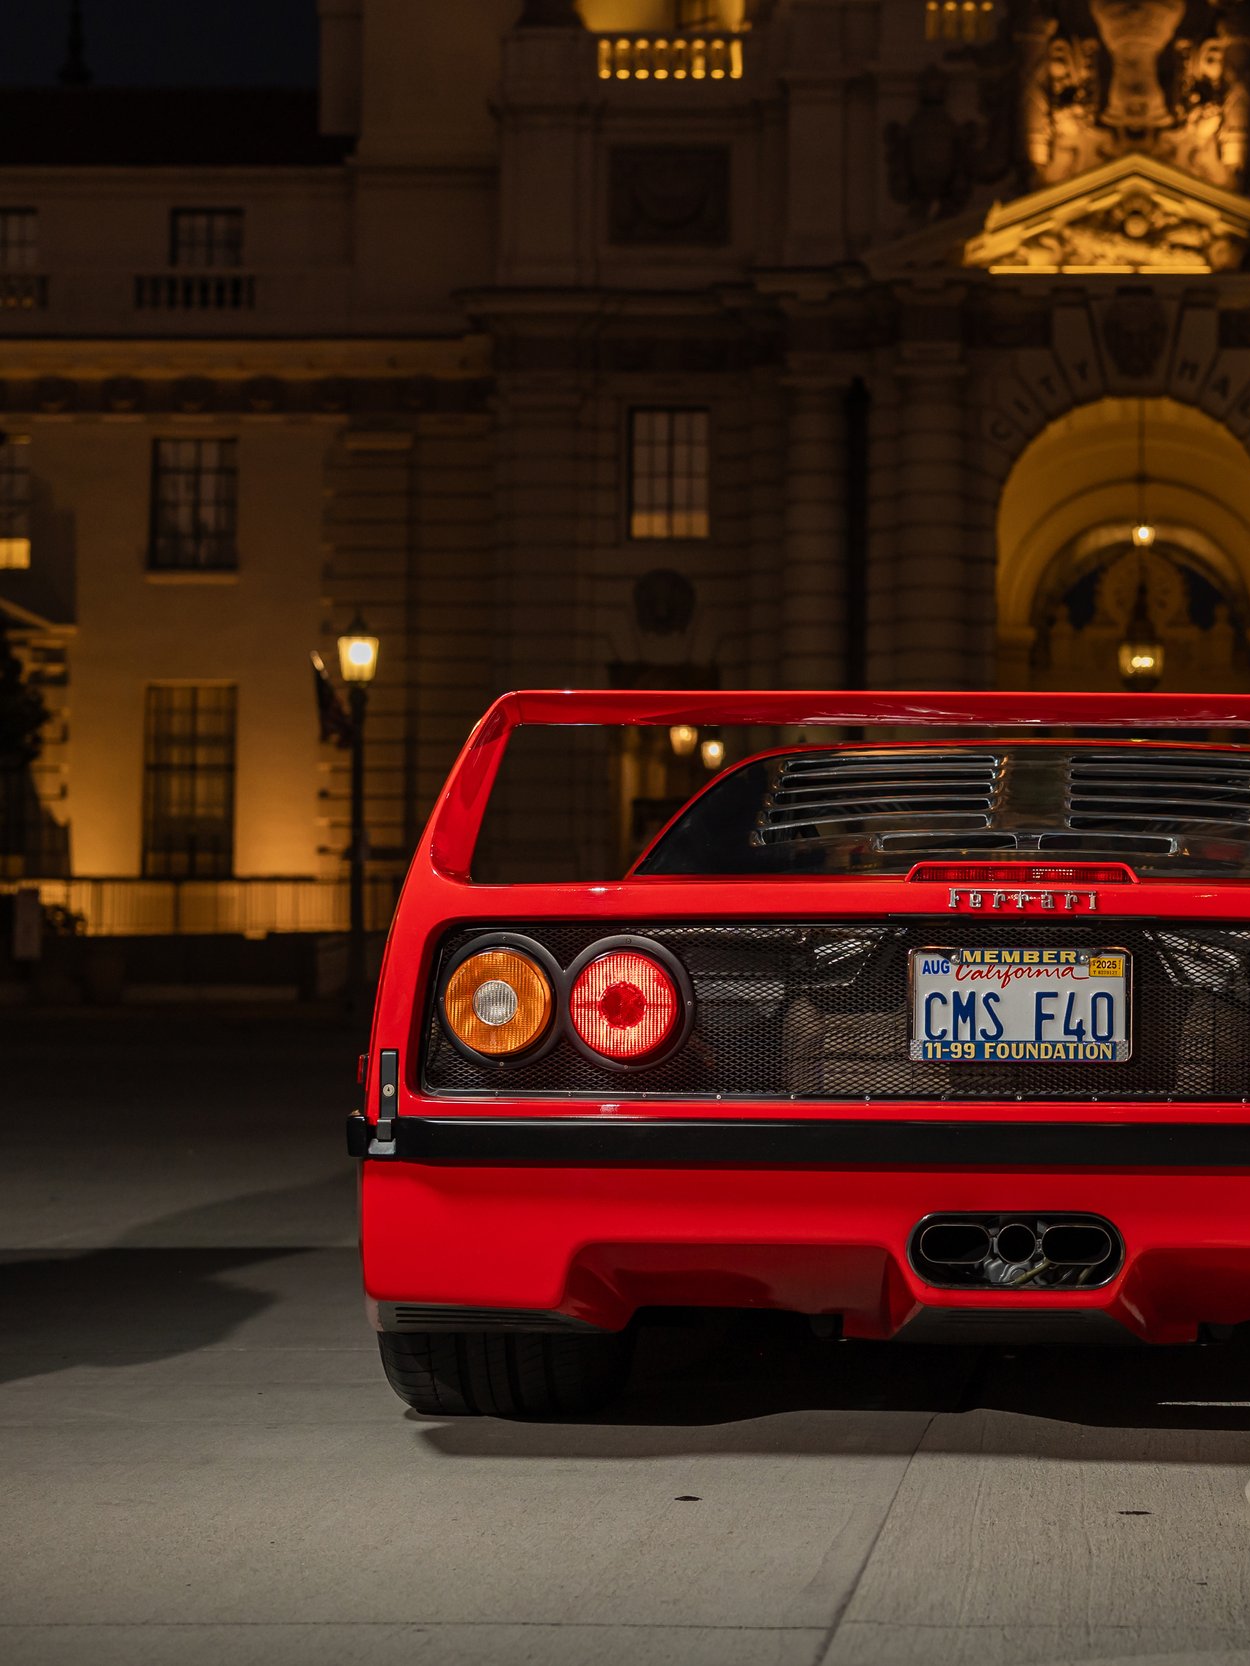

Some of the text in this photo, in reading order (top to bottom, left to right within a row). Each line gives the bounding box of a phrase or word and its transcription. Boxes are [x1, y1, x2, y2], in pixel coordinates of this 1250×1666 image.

[990, 359, 1090, 439] CITY
[948, 888, 1096, 909] Ferrari
[962, 950, 1077, 963] MEMBER
[1096, 960, 1117, 969] 2025
[922, 959, 950, 974] AUG
[955, 963, 1090, 989] California
[924, 991, 1114, 1041] CMS F40
[925, 1042, 1113, 1059] 11-99 FOUNDATION
